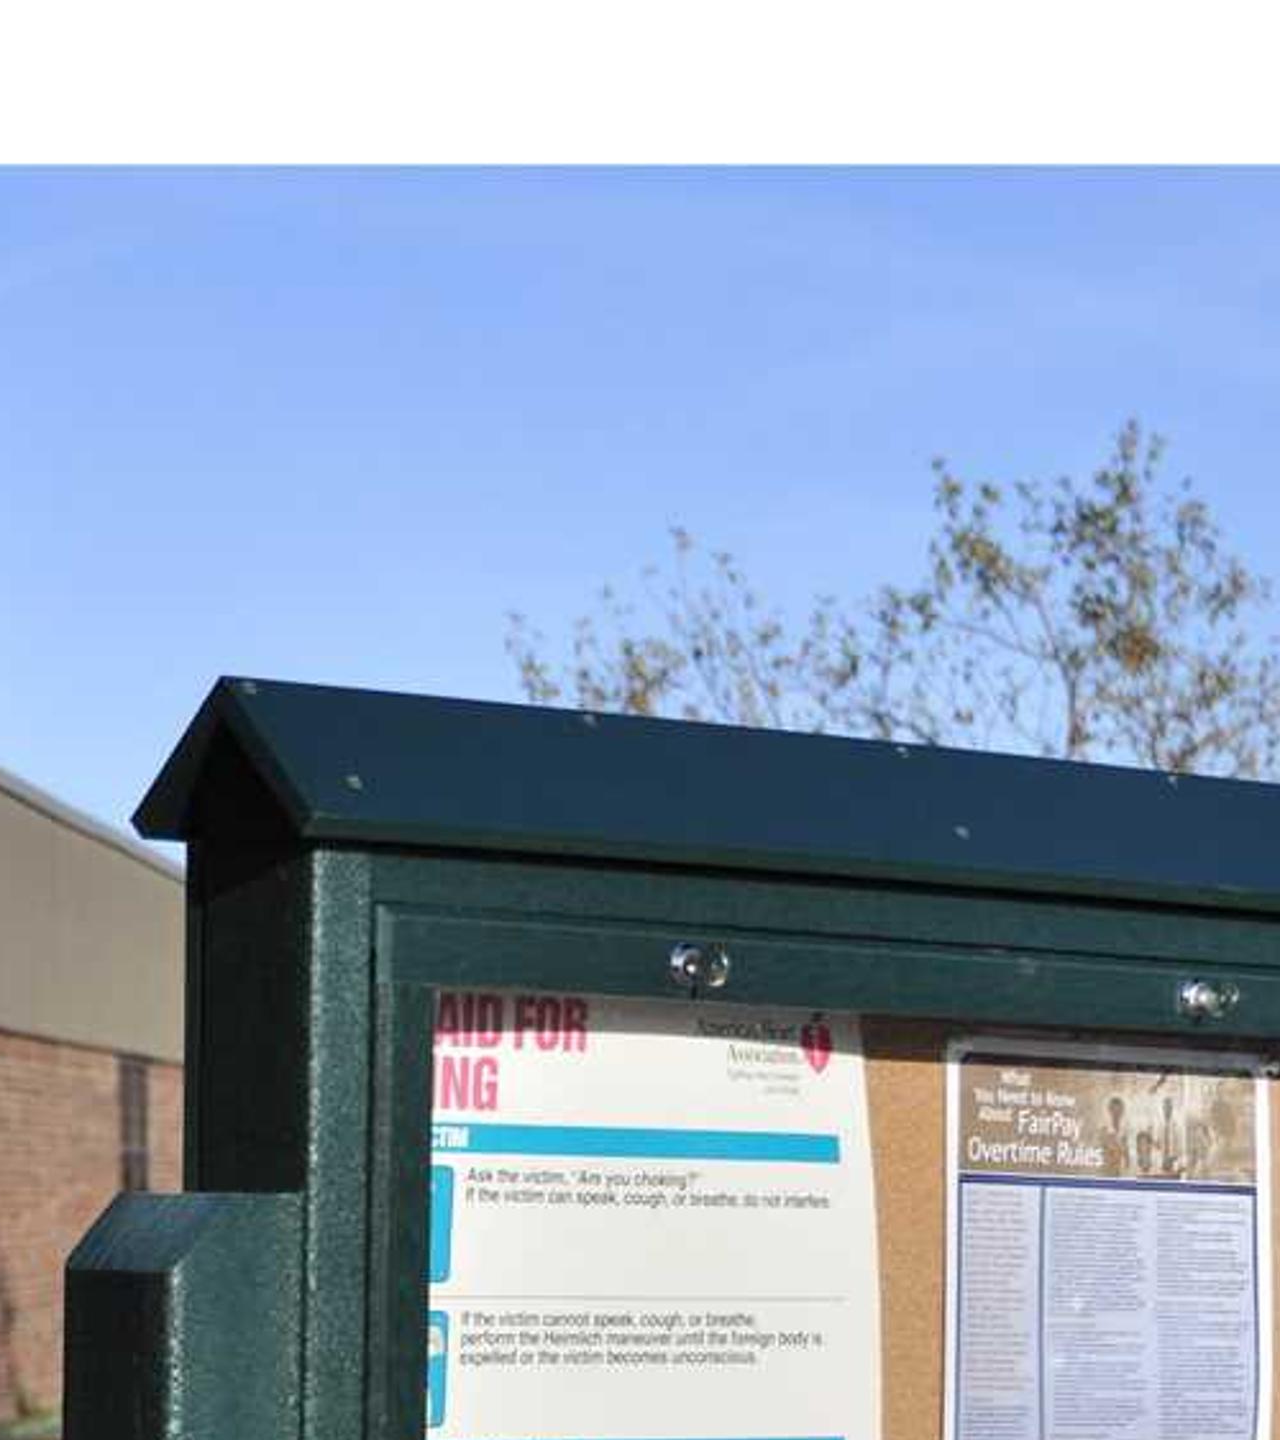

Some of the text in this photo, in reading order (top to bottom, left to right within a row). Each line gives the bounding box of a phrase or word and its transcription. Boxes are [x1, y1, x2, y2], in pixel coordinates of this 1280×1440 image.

[434, 992, 588, 1053] AID FOR
[1018, 1108, 1080, 1142] FairPay
[968, 1135, 1106, 1168] Overtime Rules
[468, 1167, 493, 1183] Ask
[497, 1168, 519, 1183] the
[606, 1173, 630, 1189] you
[478, 1187, 499, 1203] the
[504, 1188, 545, 1204] victim
[547, 1191, 572, 1204] can
[473, 1312, 495, 1327] the
[499, 1312, 541, 1327] victim
[543, 1312, 590, 1328] cannot
[460, 1331, 516, 1348] perform
[519, 1331, 540, 1345] the
[543, 1330, 603, 1346] Heimlich
[605, 1332, 672, 1346] maneuver
[675, 1331, 705, 1346] until
[707, 1331, 727, 1346] the
[778, 1331, 810, 1348] body
[460, 1350, 517, 1367] expelled
[537, 1350, 560, 1365] the
[562, 1351, 605, 1365] victim
